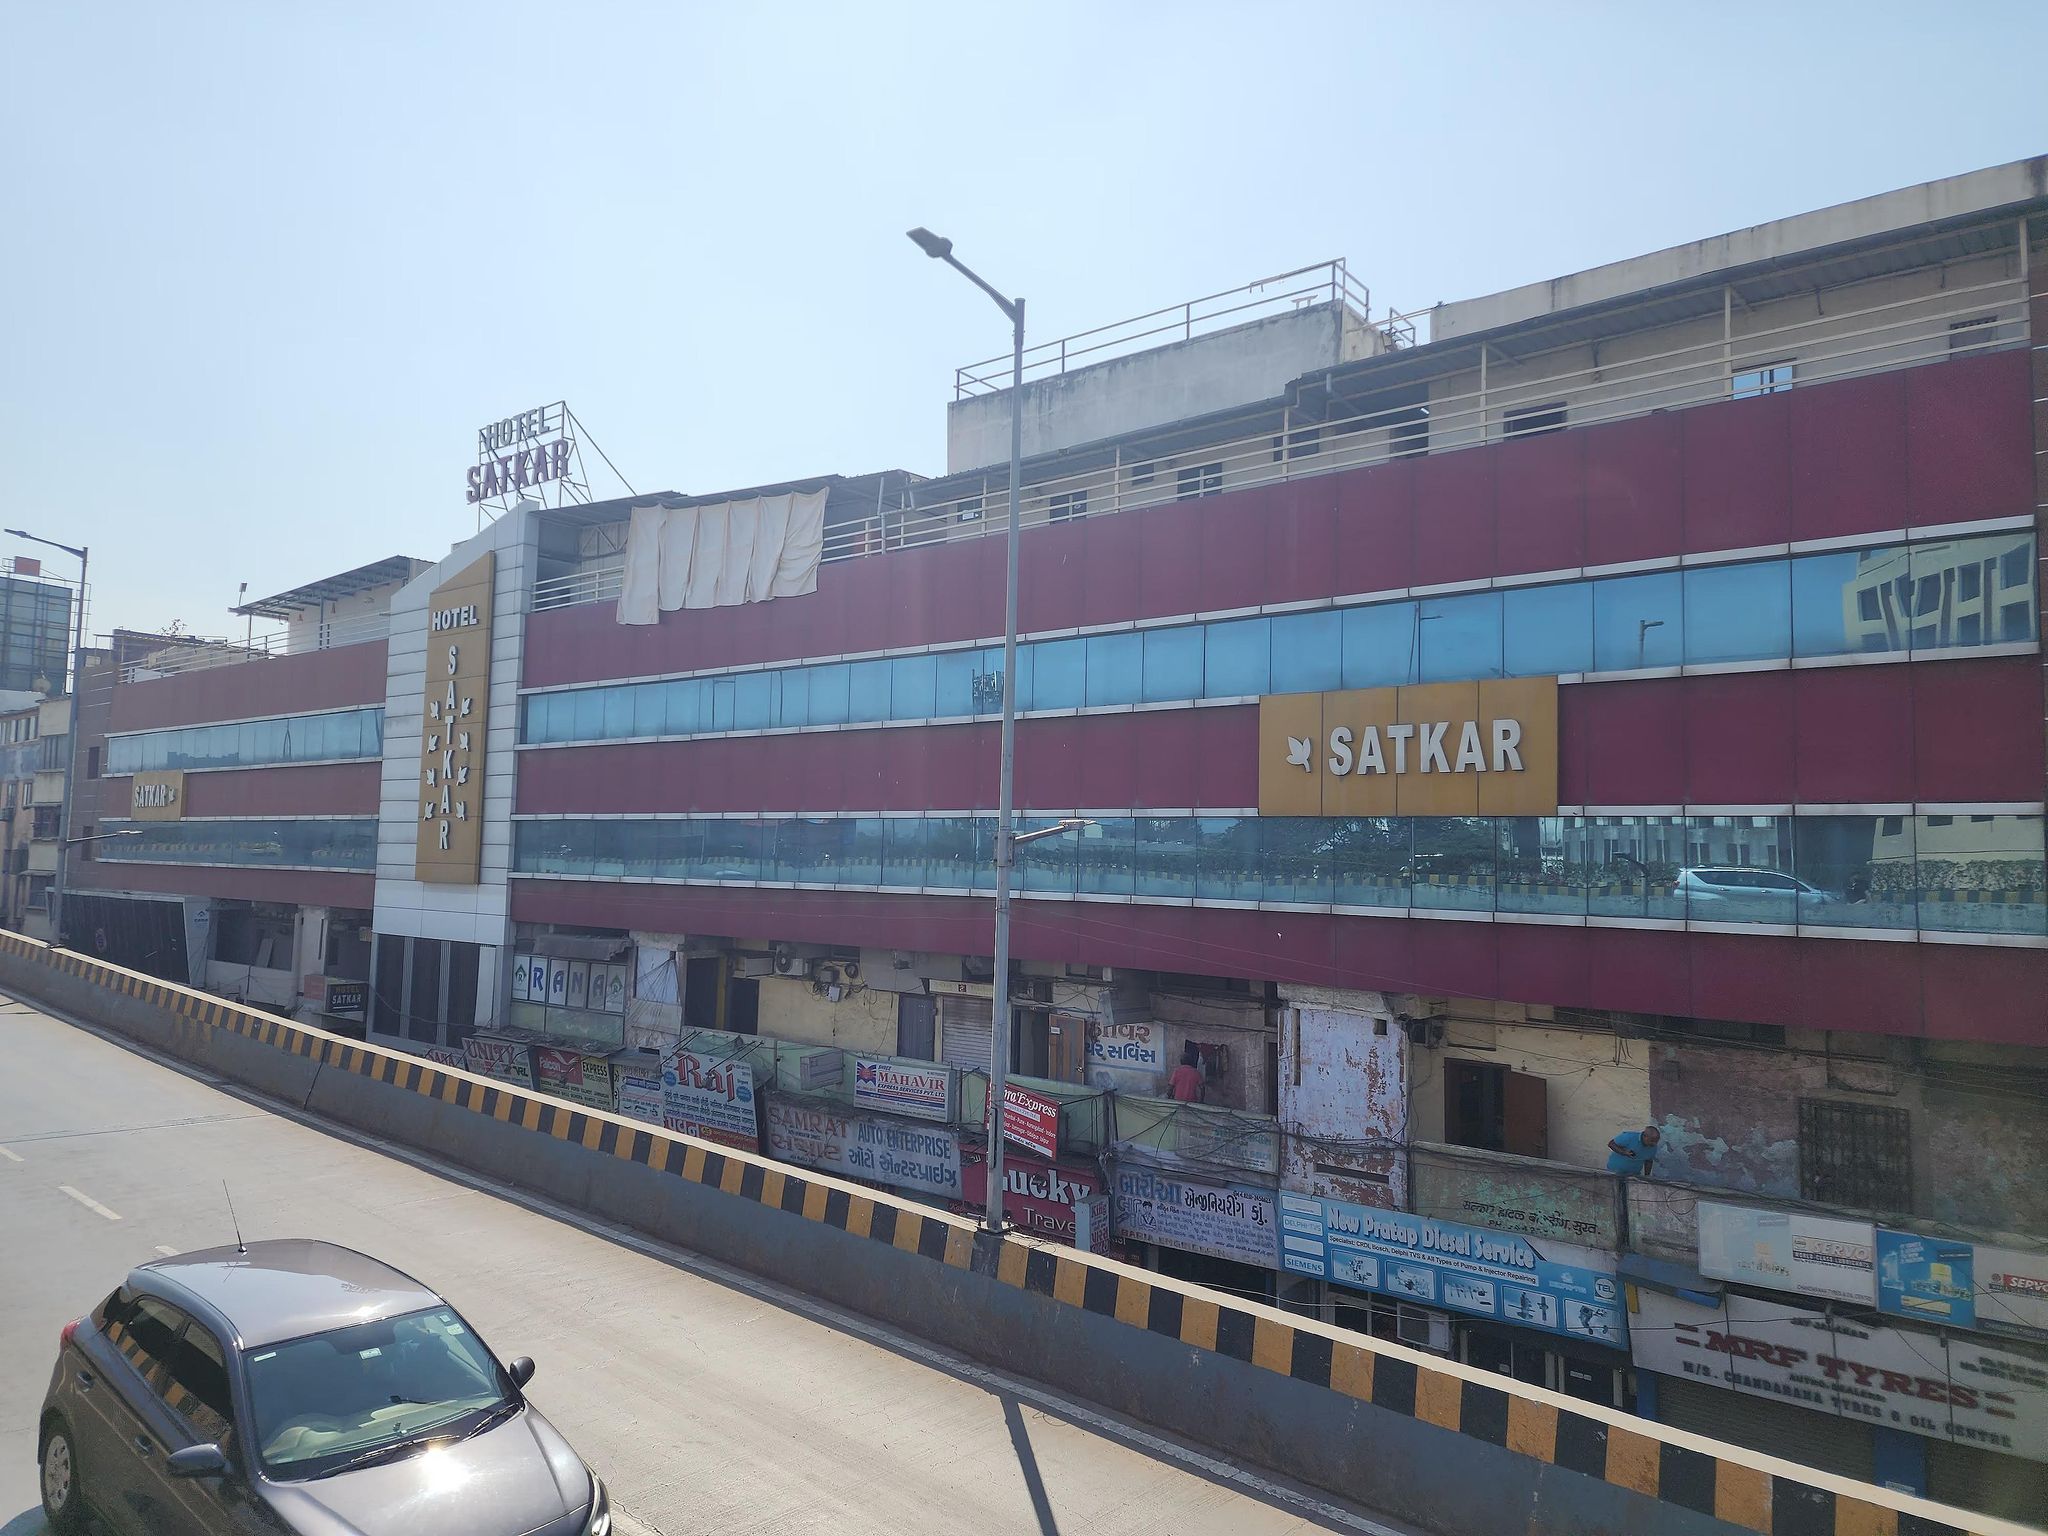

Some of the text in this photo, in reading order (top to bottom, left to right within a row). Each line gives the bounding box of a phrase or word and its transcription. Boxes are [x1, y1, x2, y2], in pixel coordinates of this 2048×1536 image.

[483, 406, 550, 452] HOTEL
[466, 438, 573, 505] SATKAR
[431, 605, 478, 632] HOTEL
[1327, 718, 1524, 776] SATKAR
[133, 784, 167, 809] SATKAR
[331, 994, 362, 1005] SATKAR
[532, 966, 606, 999] RANA
[877, 1083, 899, 1091] EXPRESS
[899, 1086, 923, 1095] SERVICES
[878, 1071, 945, 1091] MAHAVIR
[1017, 1091, 1057, 1118] Express
[857, 1122, 884, 1146] AUTO
[885, 1127, 952, 1160] ENTERPRISE
[1002, 1168, 1091, 1213] ucky
[1328, 1207, 1536, 1270] New Pratap Diesel Service
[1286, 1258, 1323, 1273] SIEMENS
[1391, 1248, 1409, 1258] Delphi
[1409, 1252, 1421, 1260] TVS
[1435, 1257, 1453, 1269] Types
[1460, 1262, 1478, 1272] Pump
[1483, 1267, 1507, 1278] Injector
[1507, 1271, 1536, 1285] Repairing
[1704, 1330, 1808, 1370] MRF
[1815, 1352, 1980, 1410] TYRES
[1831, 1395, 1883, 1419] TYRES
[1910, 1414, 1937, 1431] OIL
